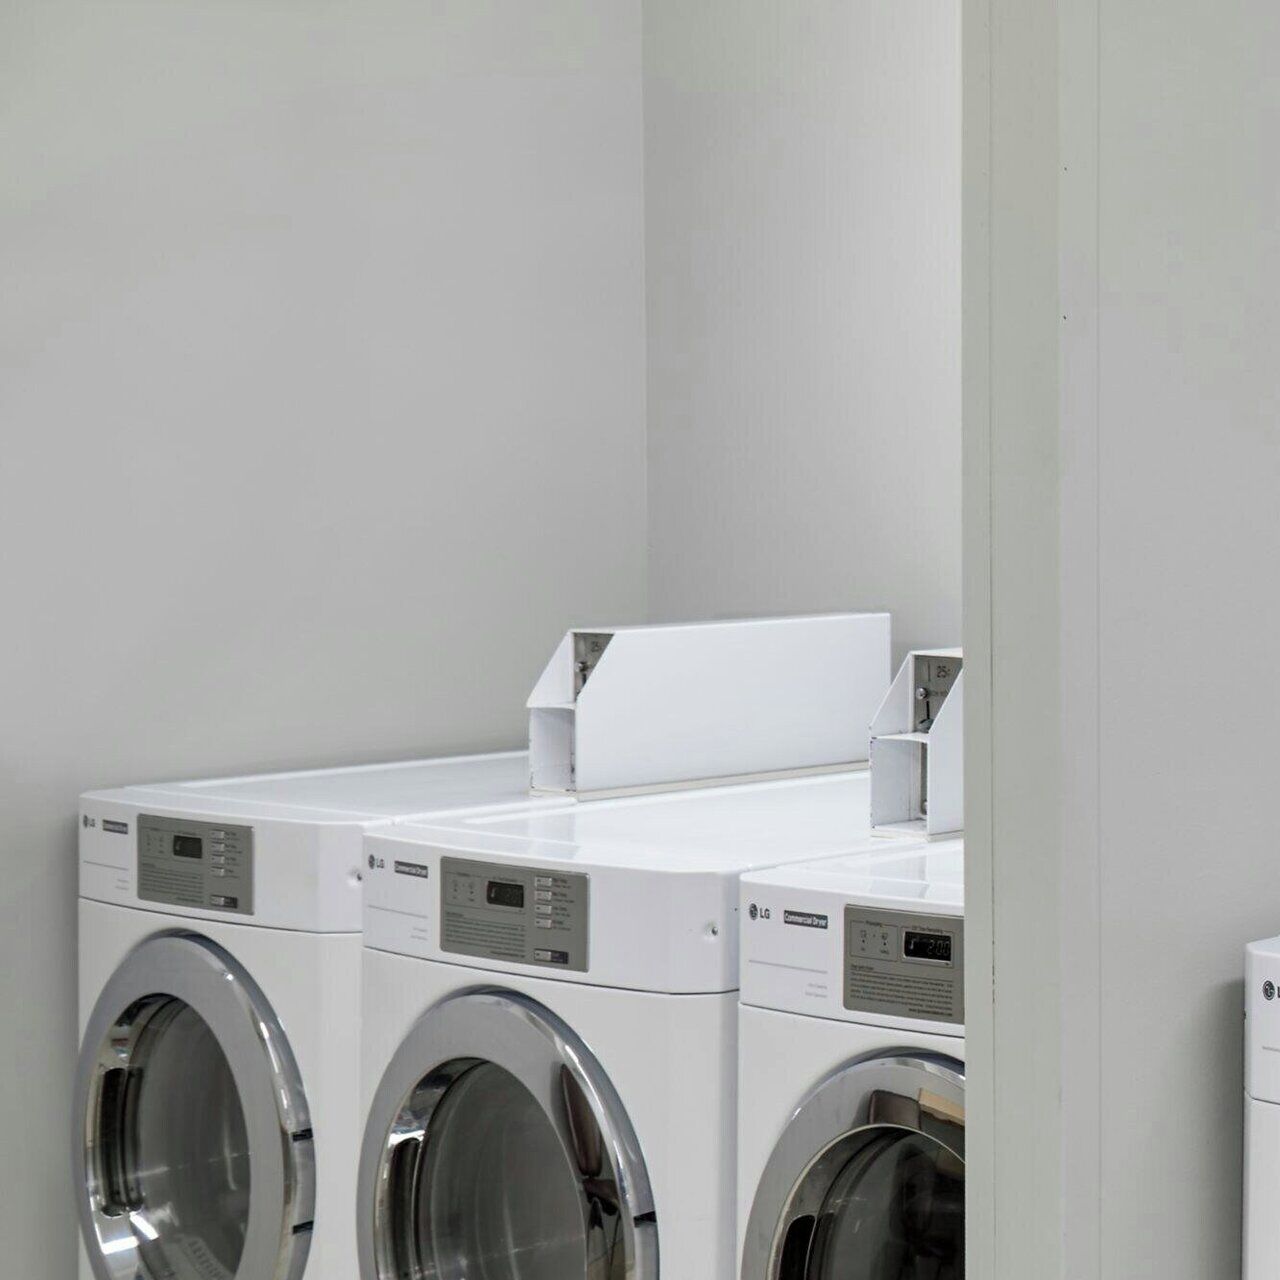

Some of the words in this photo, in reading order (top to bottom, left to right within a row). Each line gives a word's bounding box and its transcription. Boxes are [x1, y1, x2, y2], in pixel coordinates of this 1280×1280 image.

[759, 908, 770, 919] LG
[784, 911, 812, 925] Commercial
[812, 916, 828, 928] Dryer
